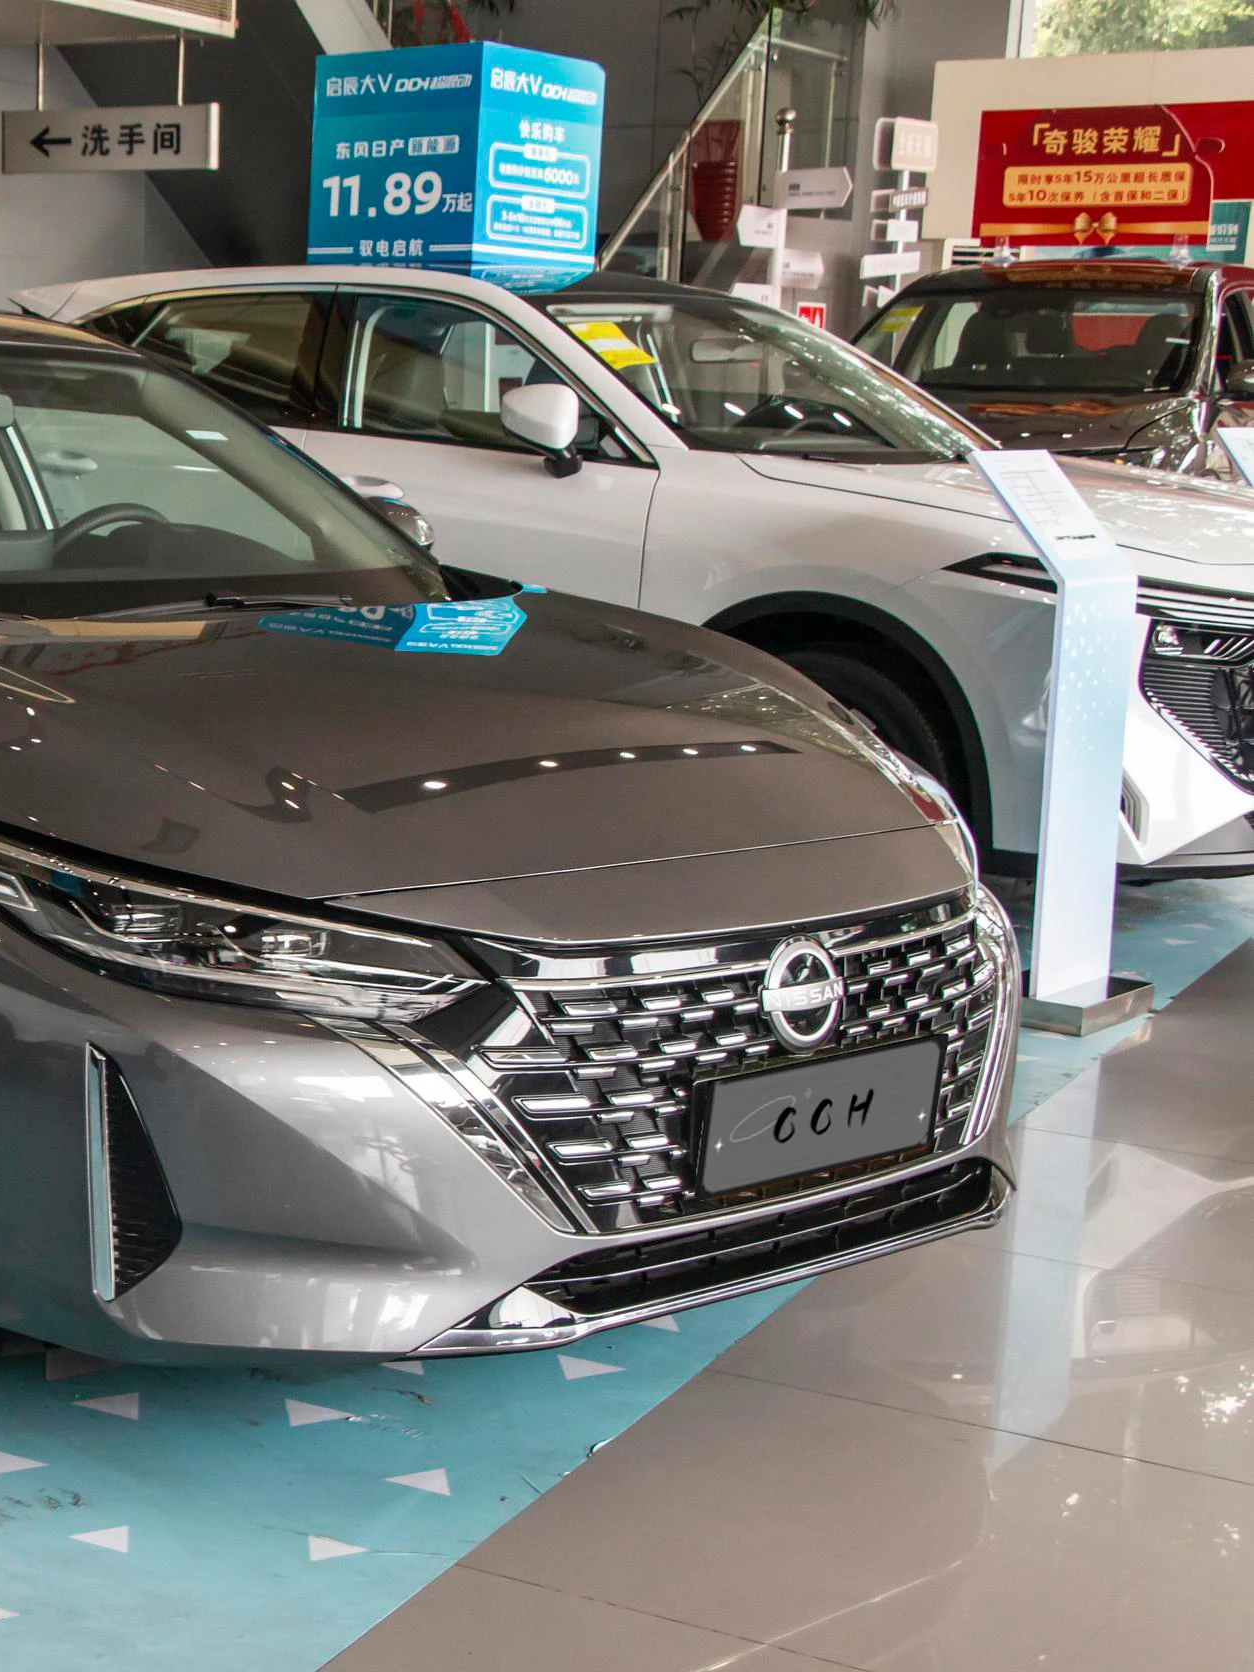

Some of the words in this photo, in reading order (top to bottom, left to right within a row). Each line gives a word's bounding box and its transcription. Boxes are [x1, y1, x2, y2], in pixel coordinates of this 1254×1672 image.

[326, 73, 393, 97] 启辰大V
[490, 67, 543, 95] 启辰大V
[81, 123, 182, 156] 洗手间
[335, 138, 405, 160] 东风日产
[411, 137, 457, 155] 新能源
[1032, 123, 1181, 157] 「奇骏荣耀」
[359, 238, 424, 257] 驭电启航
[766, 980, 844, 1009] NISSAN
